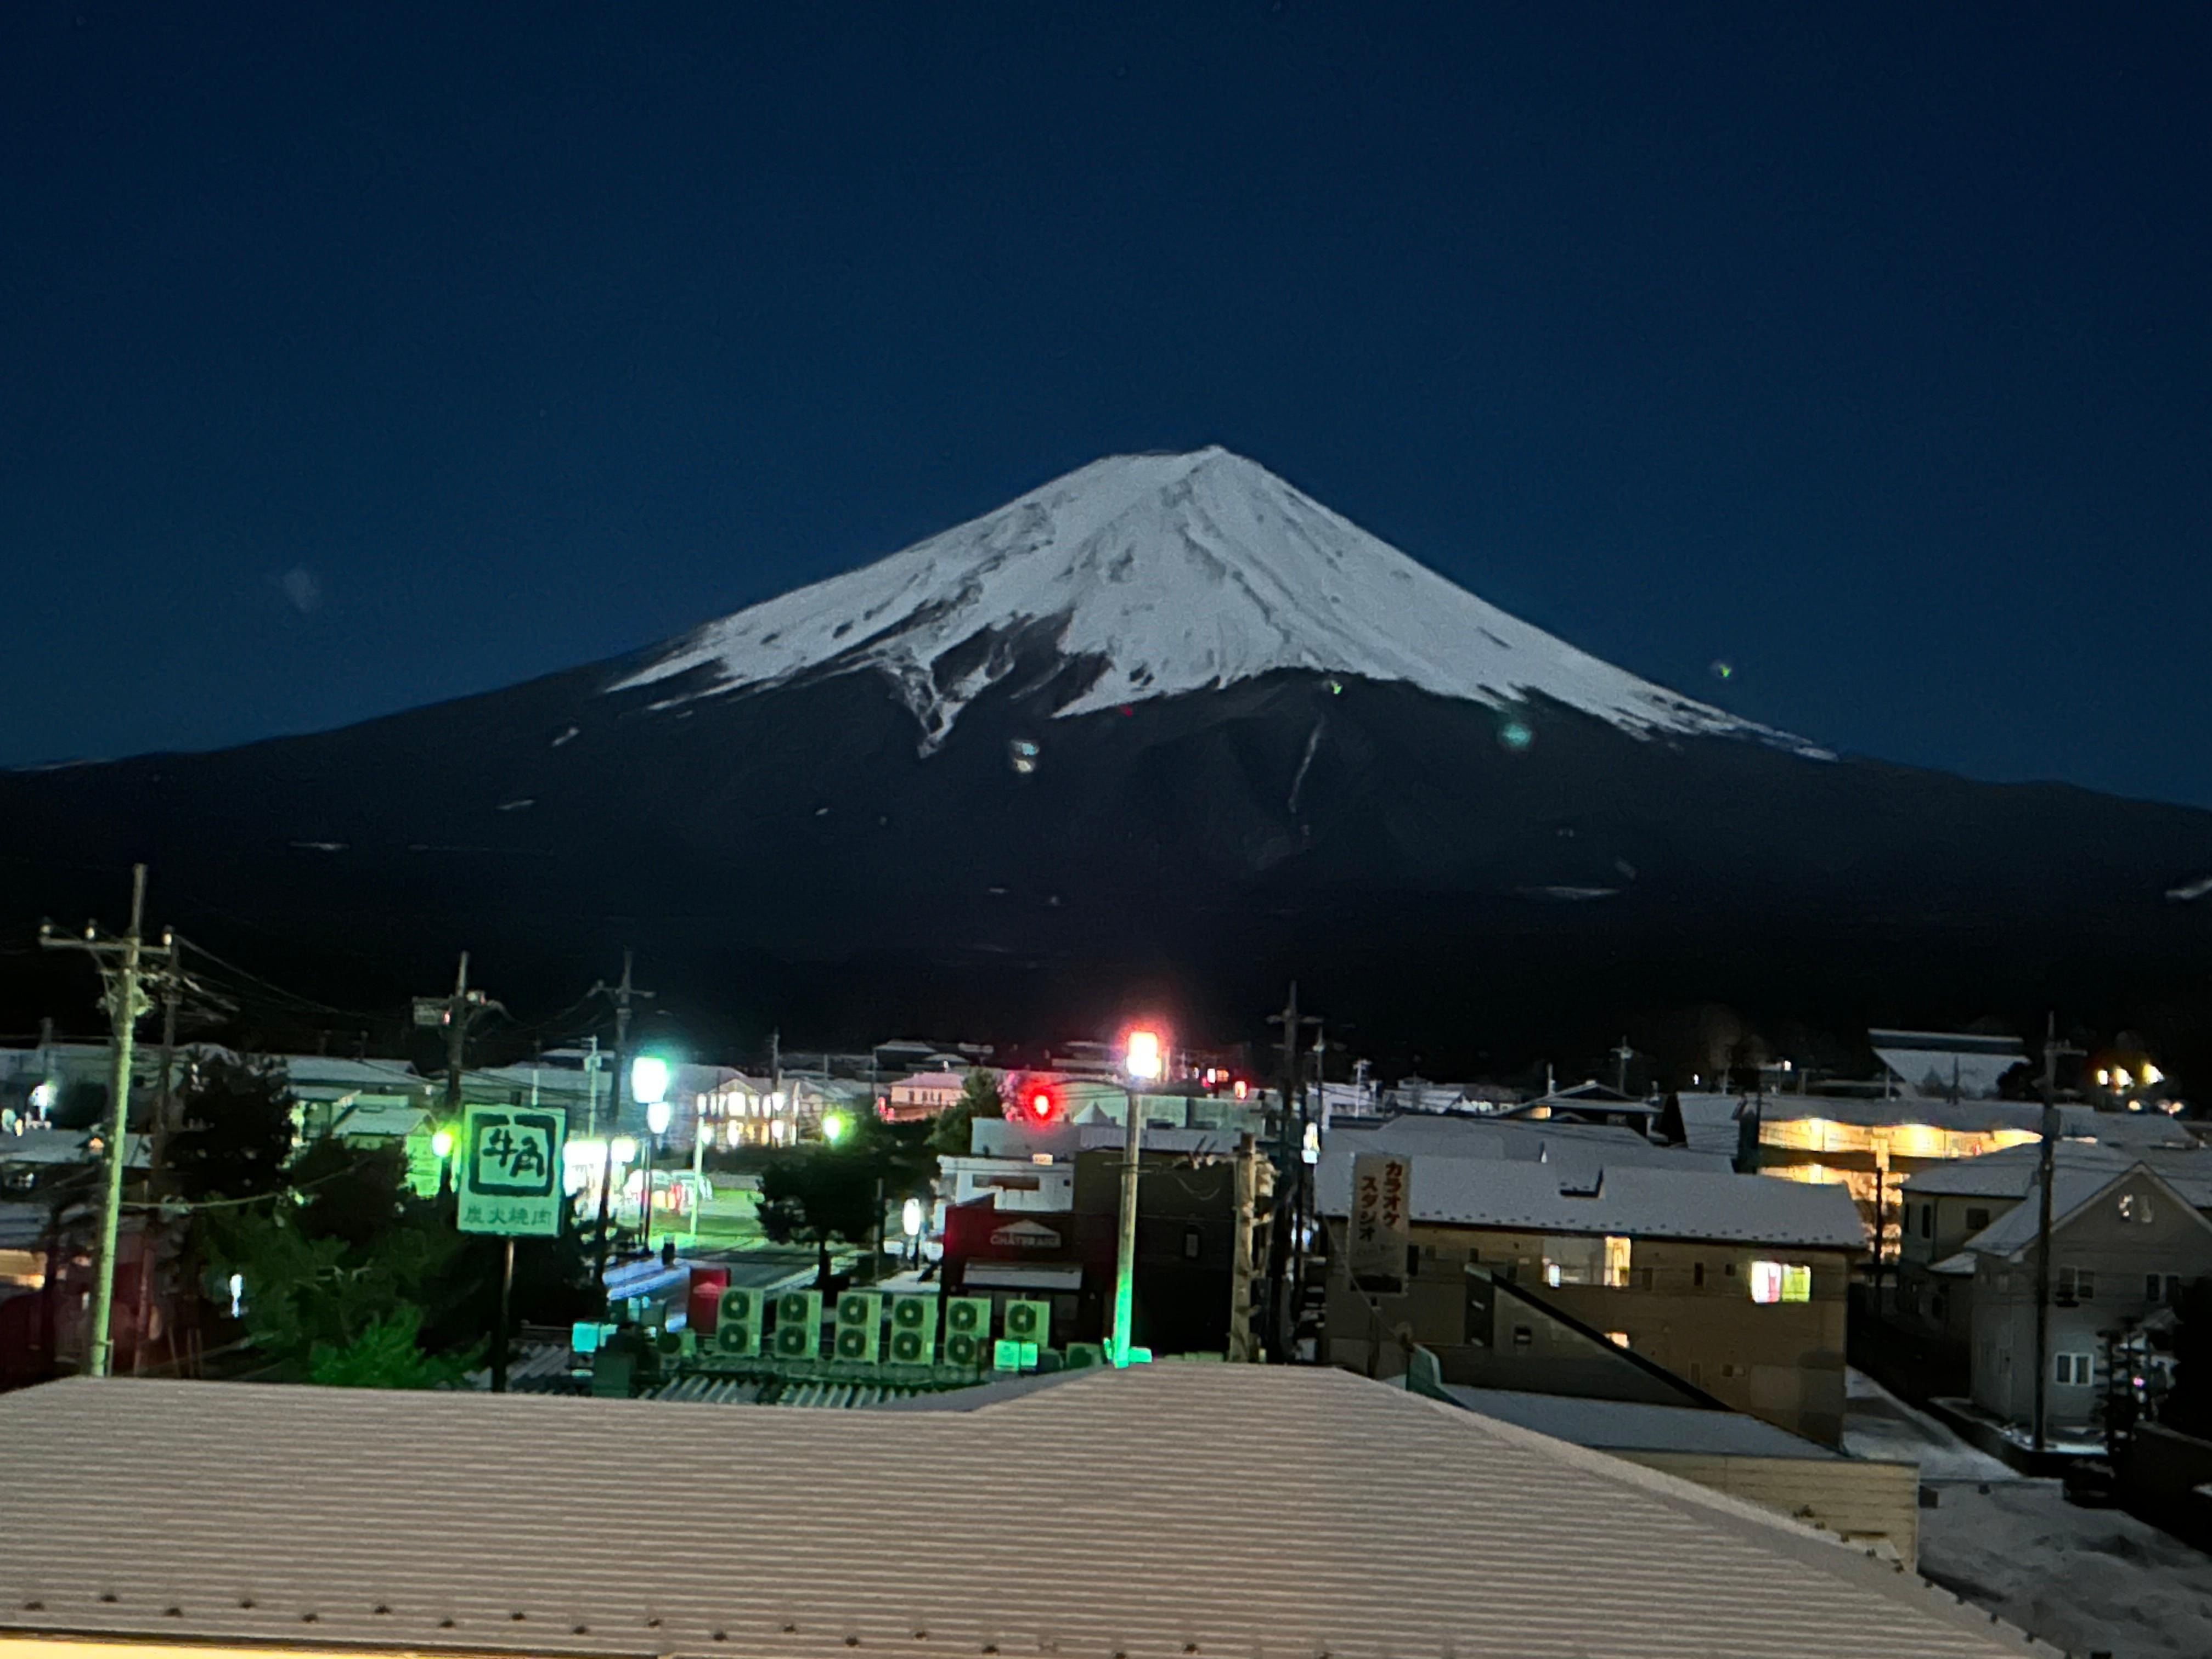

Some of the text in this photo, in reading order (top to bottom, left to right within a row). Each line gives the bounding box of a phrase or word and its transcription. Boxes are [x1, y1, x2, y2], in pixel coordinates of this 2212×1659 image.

[482, 1128, 545, 1177] 牛角
[1382, 1160, 1402, 1229] カラオケ
